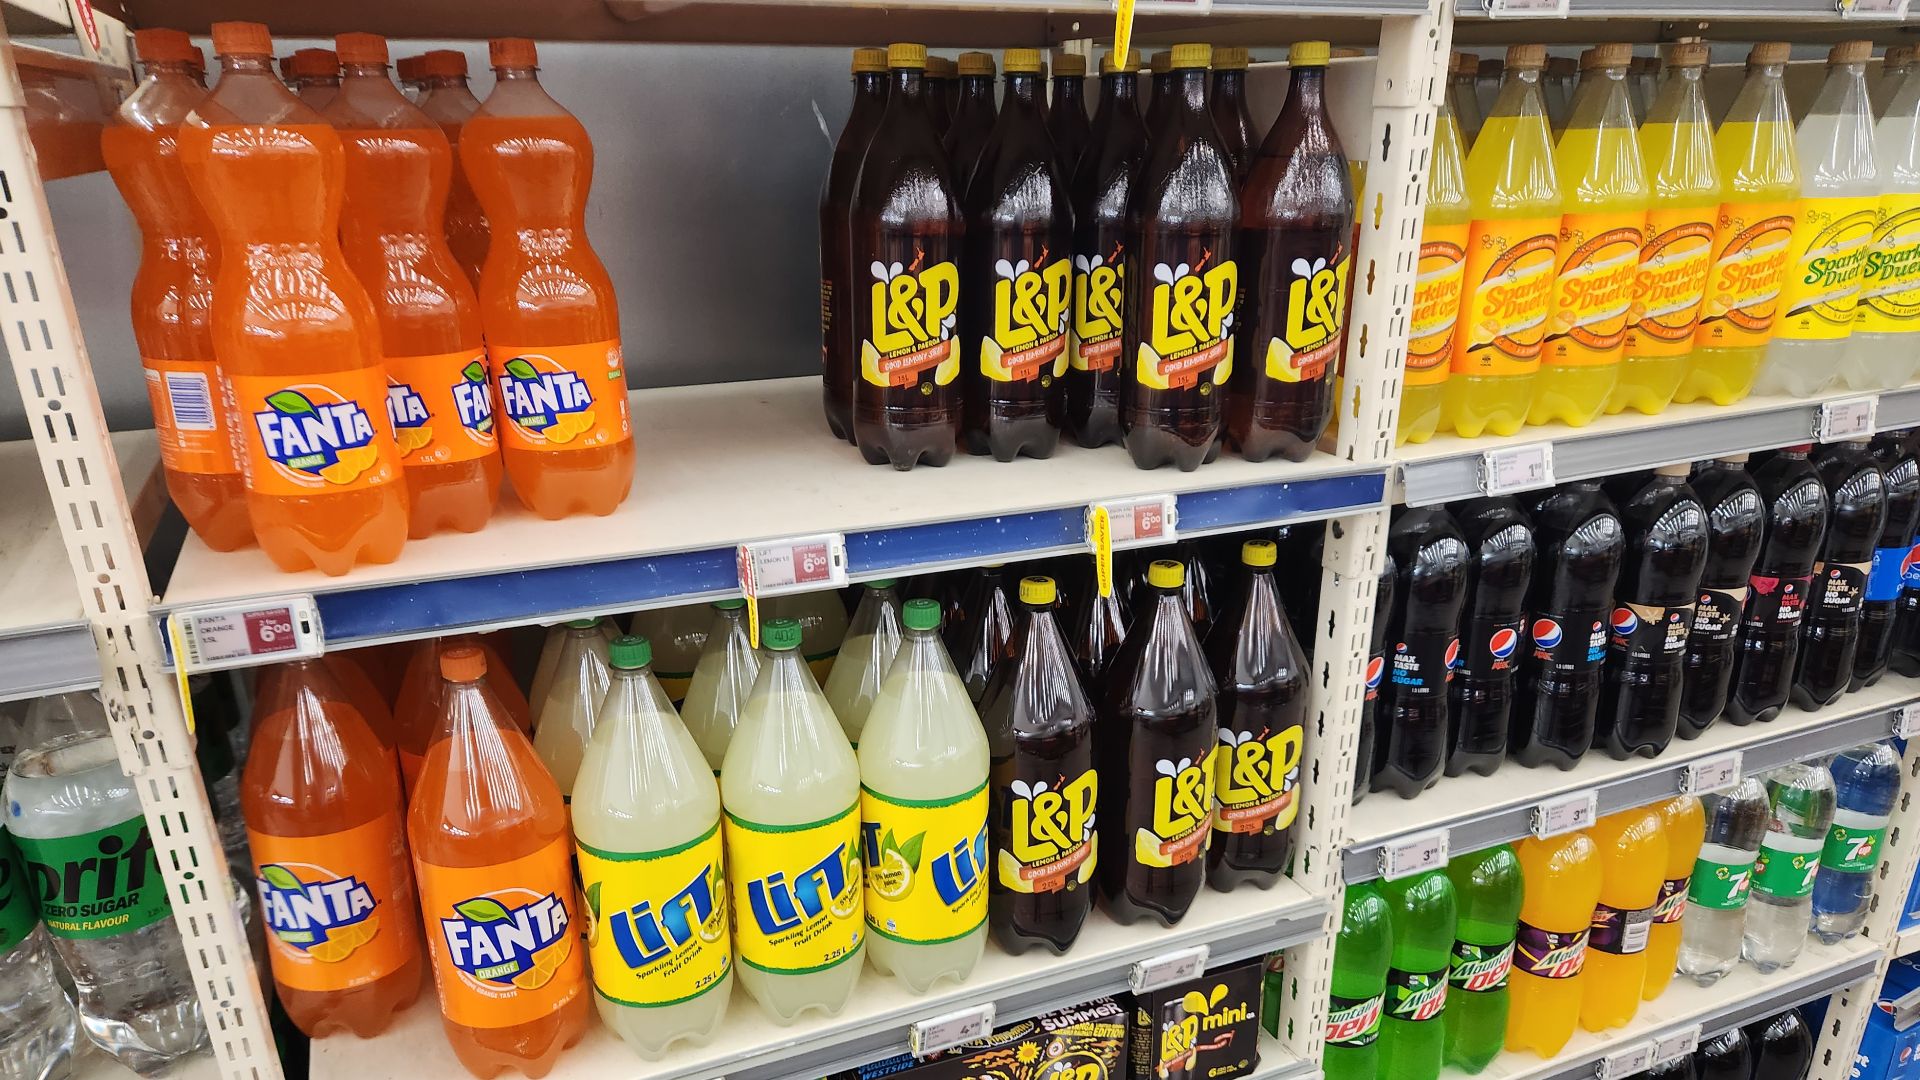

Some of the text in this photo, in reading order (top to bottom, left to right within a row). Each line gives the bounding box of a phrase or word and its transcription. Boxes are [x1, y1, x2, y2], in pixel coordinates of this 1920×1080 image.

[872, 262, 959, 353] L&P
[995, 258, 1072, 349] L&P
[1076, 266, 1124, 338] L&
[1152, 260, 1237, 355] L&P
[500, 374, 590, 417] FANTA
[254, 401, 373, 459] FANTA
[1697, 610, 1721, 618] TASTE
[1698, 604, 1718, 612] MAX
[1590, 630, 1606, 640] MAX
[1694, 623, 1722, 631] SUGAR
[1394, 654, 1416, 663] MAX
[1394, 661, 1420, 671] TASTE
[1392, 676, 1424, 686] SUGAR
[1216, 725, 1303, 804] L&P
[1013, 769, 1097, 863] L&P
[44, 905, 77, 918] ZERO
[80, 893, 140, 918] SUGAR
[257, 879, 375, 929] FANTA
[83, 914, 129, 930] FLAVOUR
[442, 897, 568, 966] FANTA
[769, 914, 828, 946] Sparkling Lemon
[794, 920, 833, 948] Fruit Drink
[478, 963, 518, 980] ORANGE
[636, 940, 698, 980] Sparkling Lemon
[663, 946, 702, 978] Fruit Drink
[1203, 1002, 1247, 1031] mini
[1093, 1027, 1125, 1038] EDITION
[1161, 1015, 1199, 1062] L&P
[863, 1061, 914, 1080] WESTSIDE
